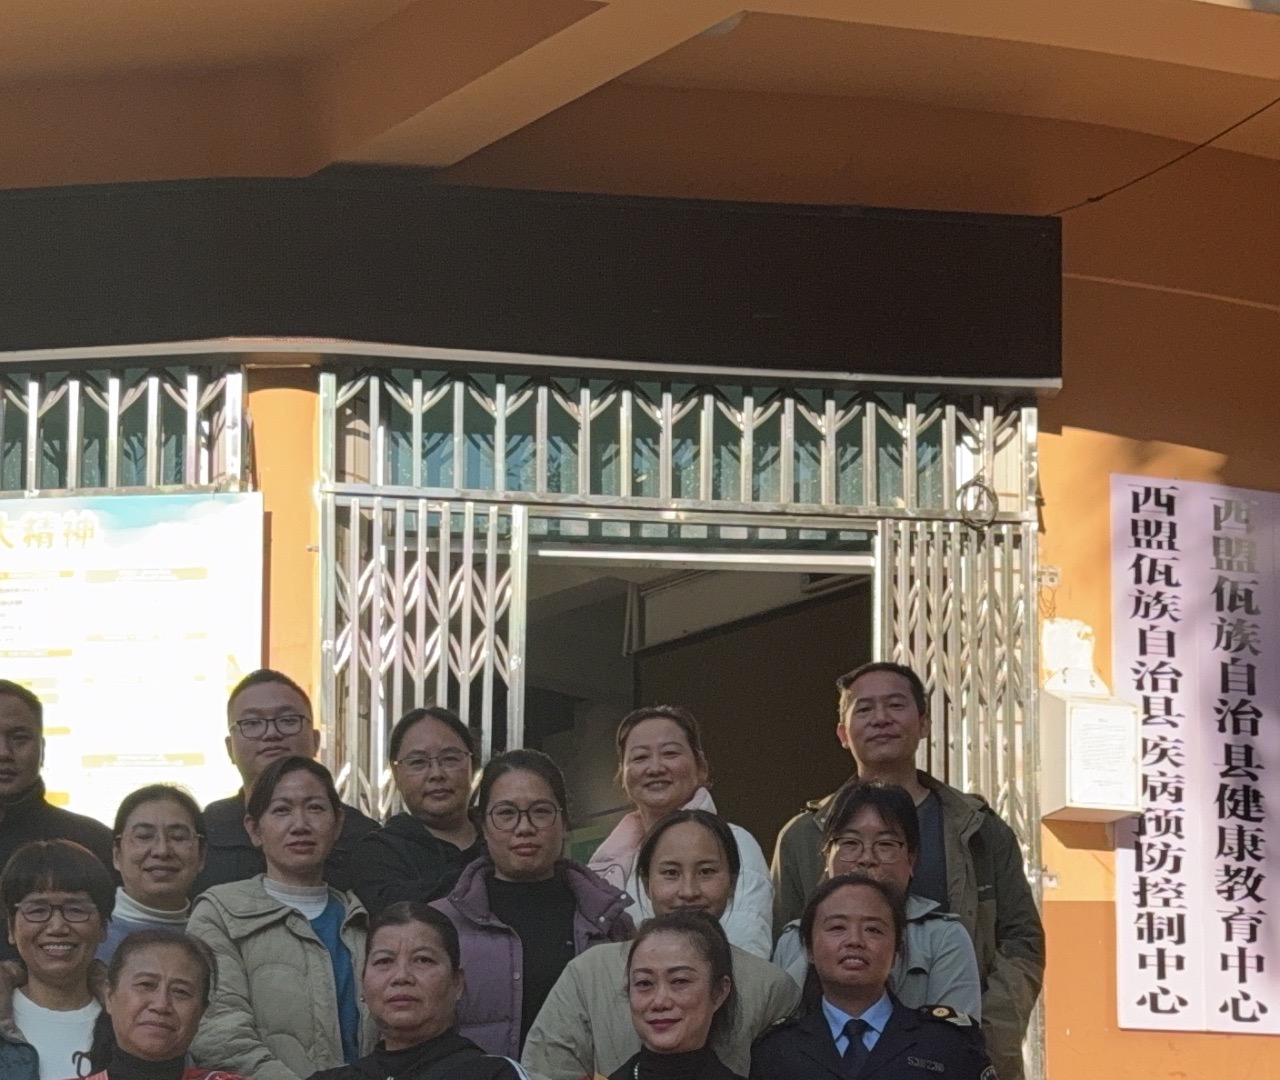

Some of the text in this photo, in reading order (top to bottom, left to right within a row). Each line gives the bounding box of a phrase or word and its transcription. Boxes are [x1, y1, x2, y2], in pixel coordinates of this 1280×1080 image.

[1127, 484, 1188, 1016] 西盟佤族自治县疾病预防控制中心
[1209, 495, 1268, 1023] 西盟佤族自治县健康教育中心
